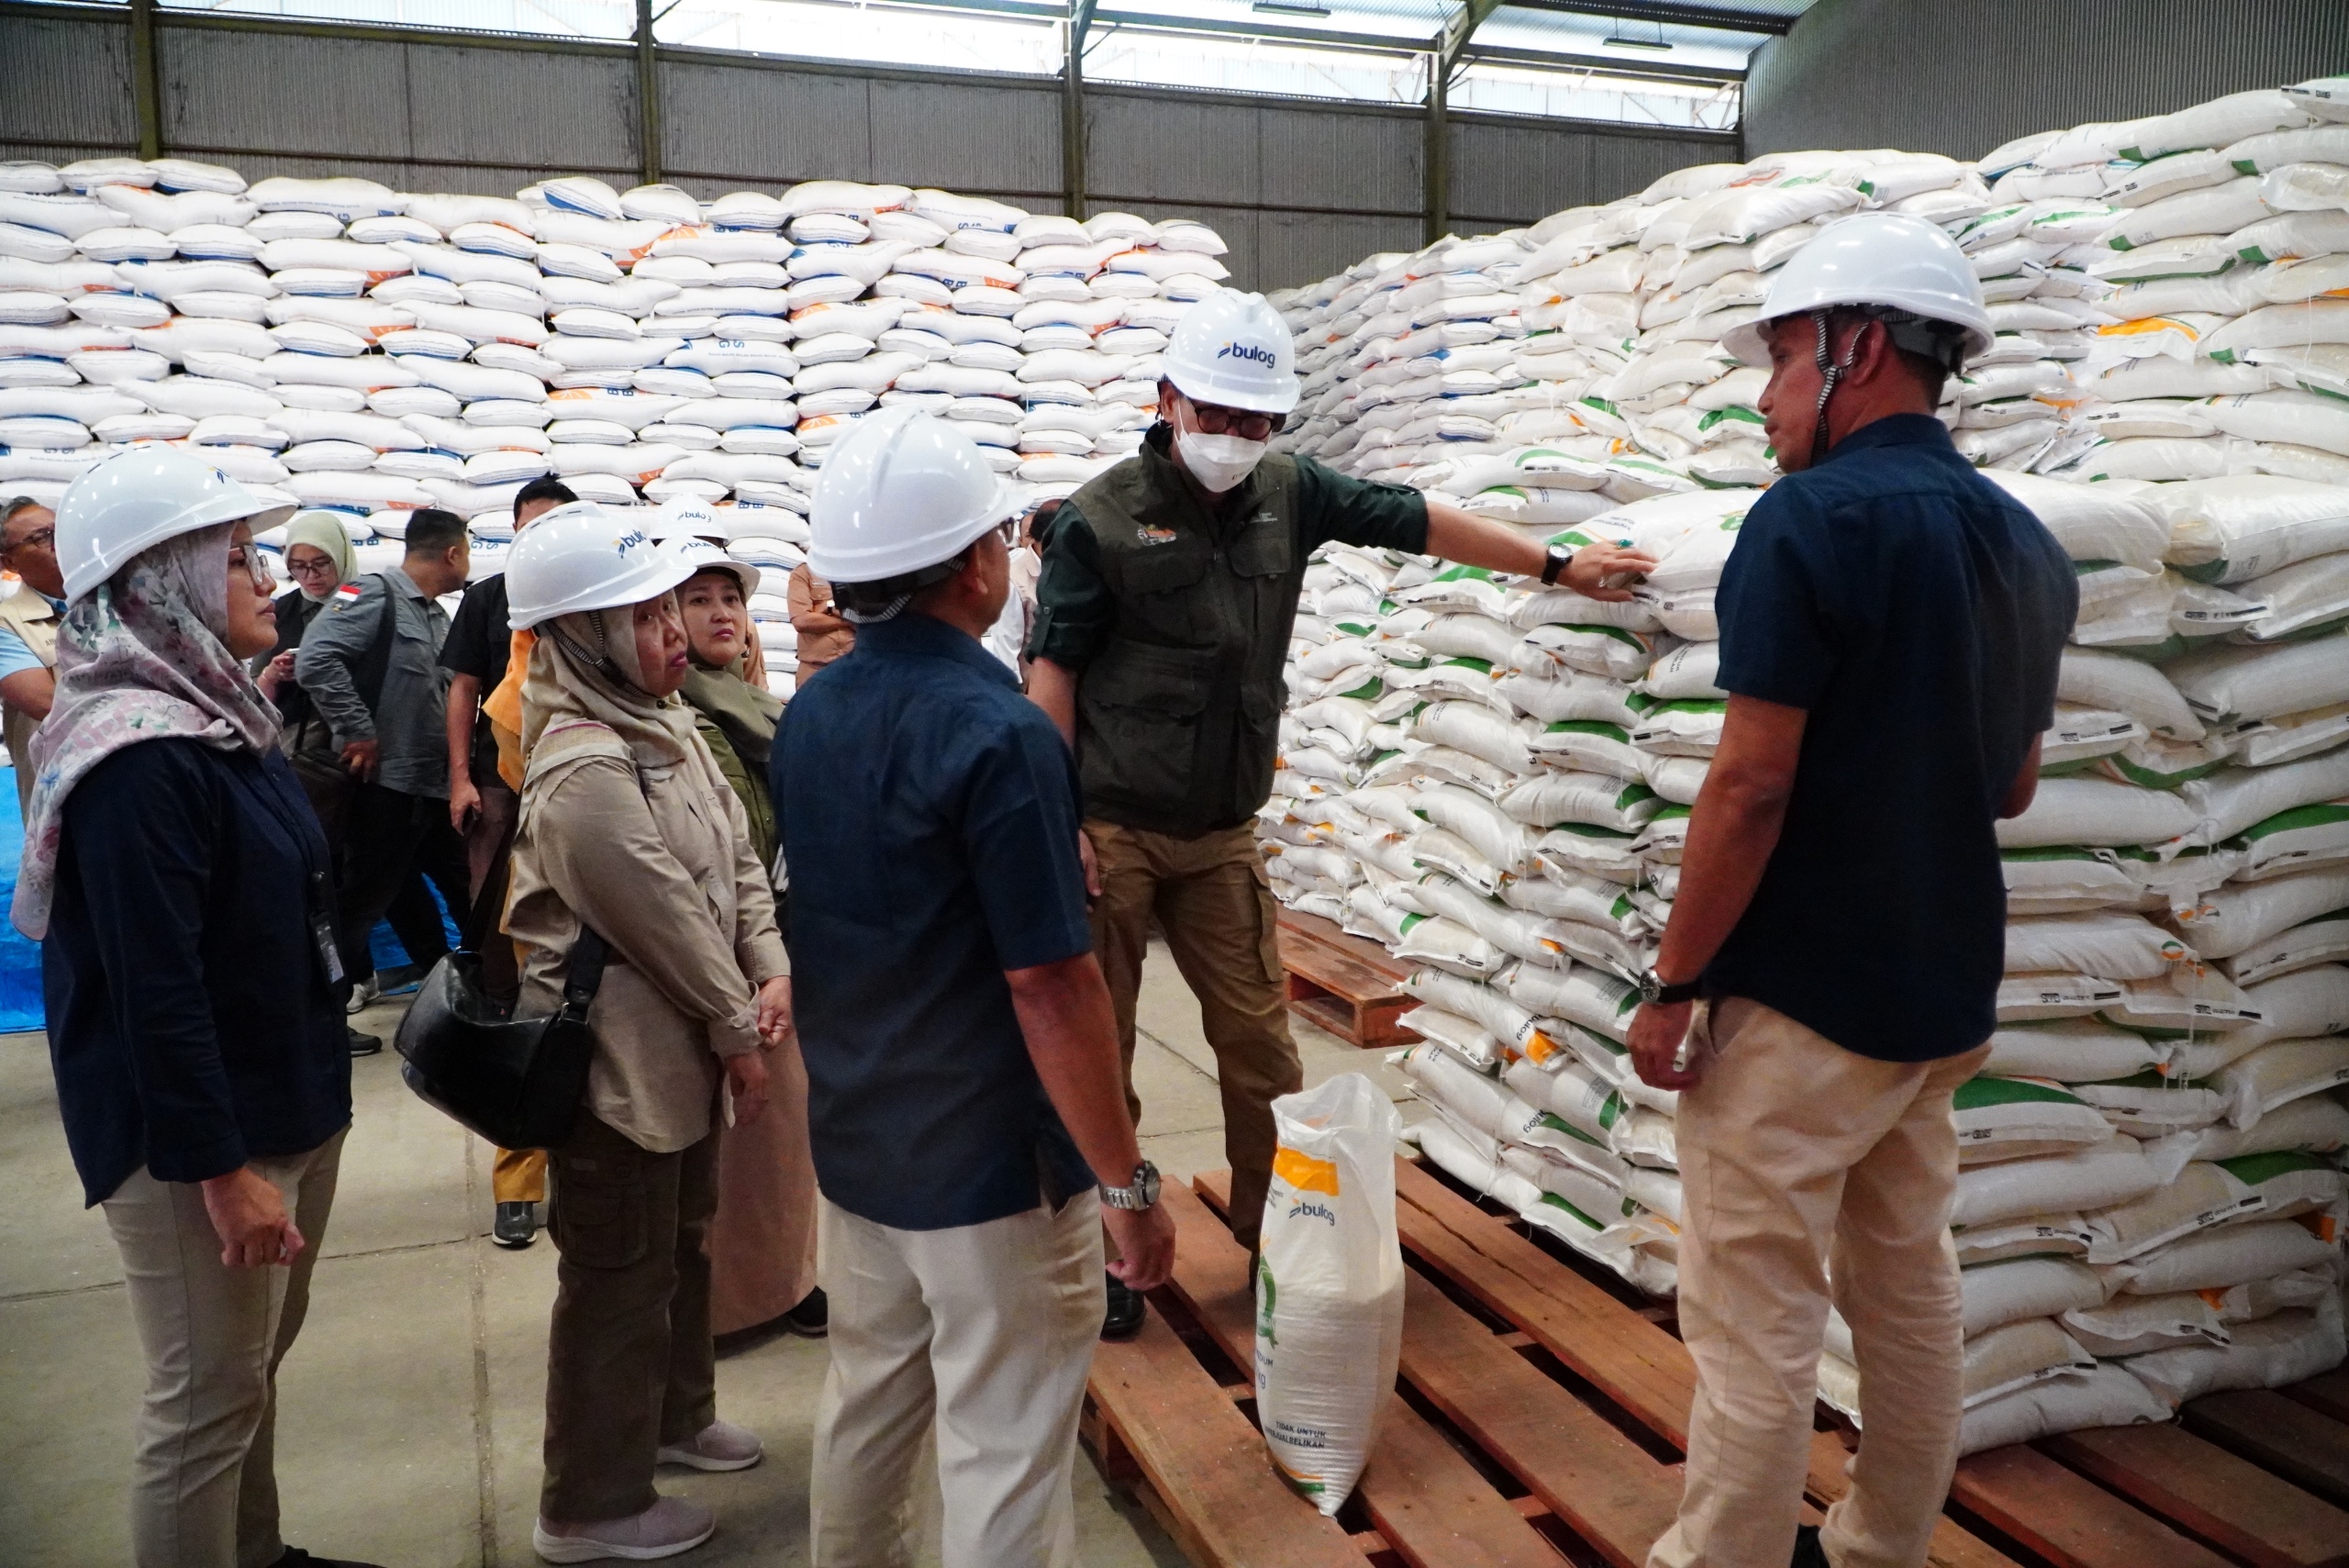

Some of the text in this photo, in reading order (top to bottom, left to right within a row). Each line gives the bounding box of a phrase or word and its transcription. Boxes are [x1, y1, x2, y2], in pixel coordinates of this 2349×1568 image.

[1232, 342, 1275, 369] bulog
[1302, 1202, 1335, 1227] bulog
[1275, 1421, 1326, 1439] TIDAK UNTUK
